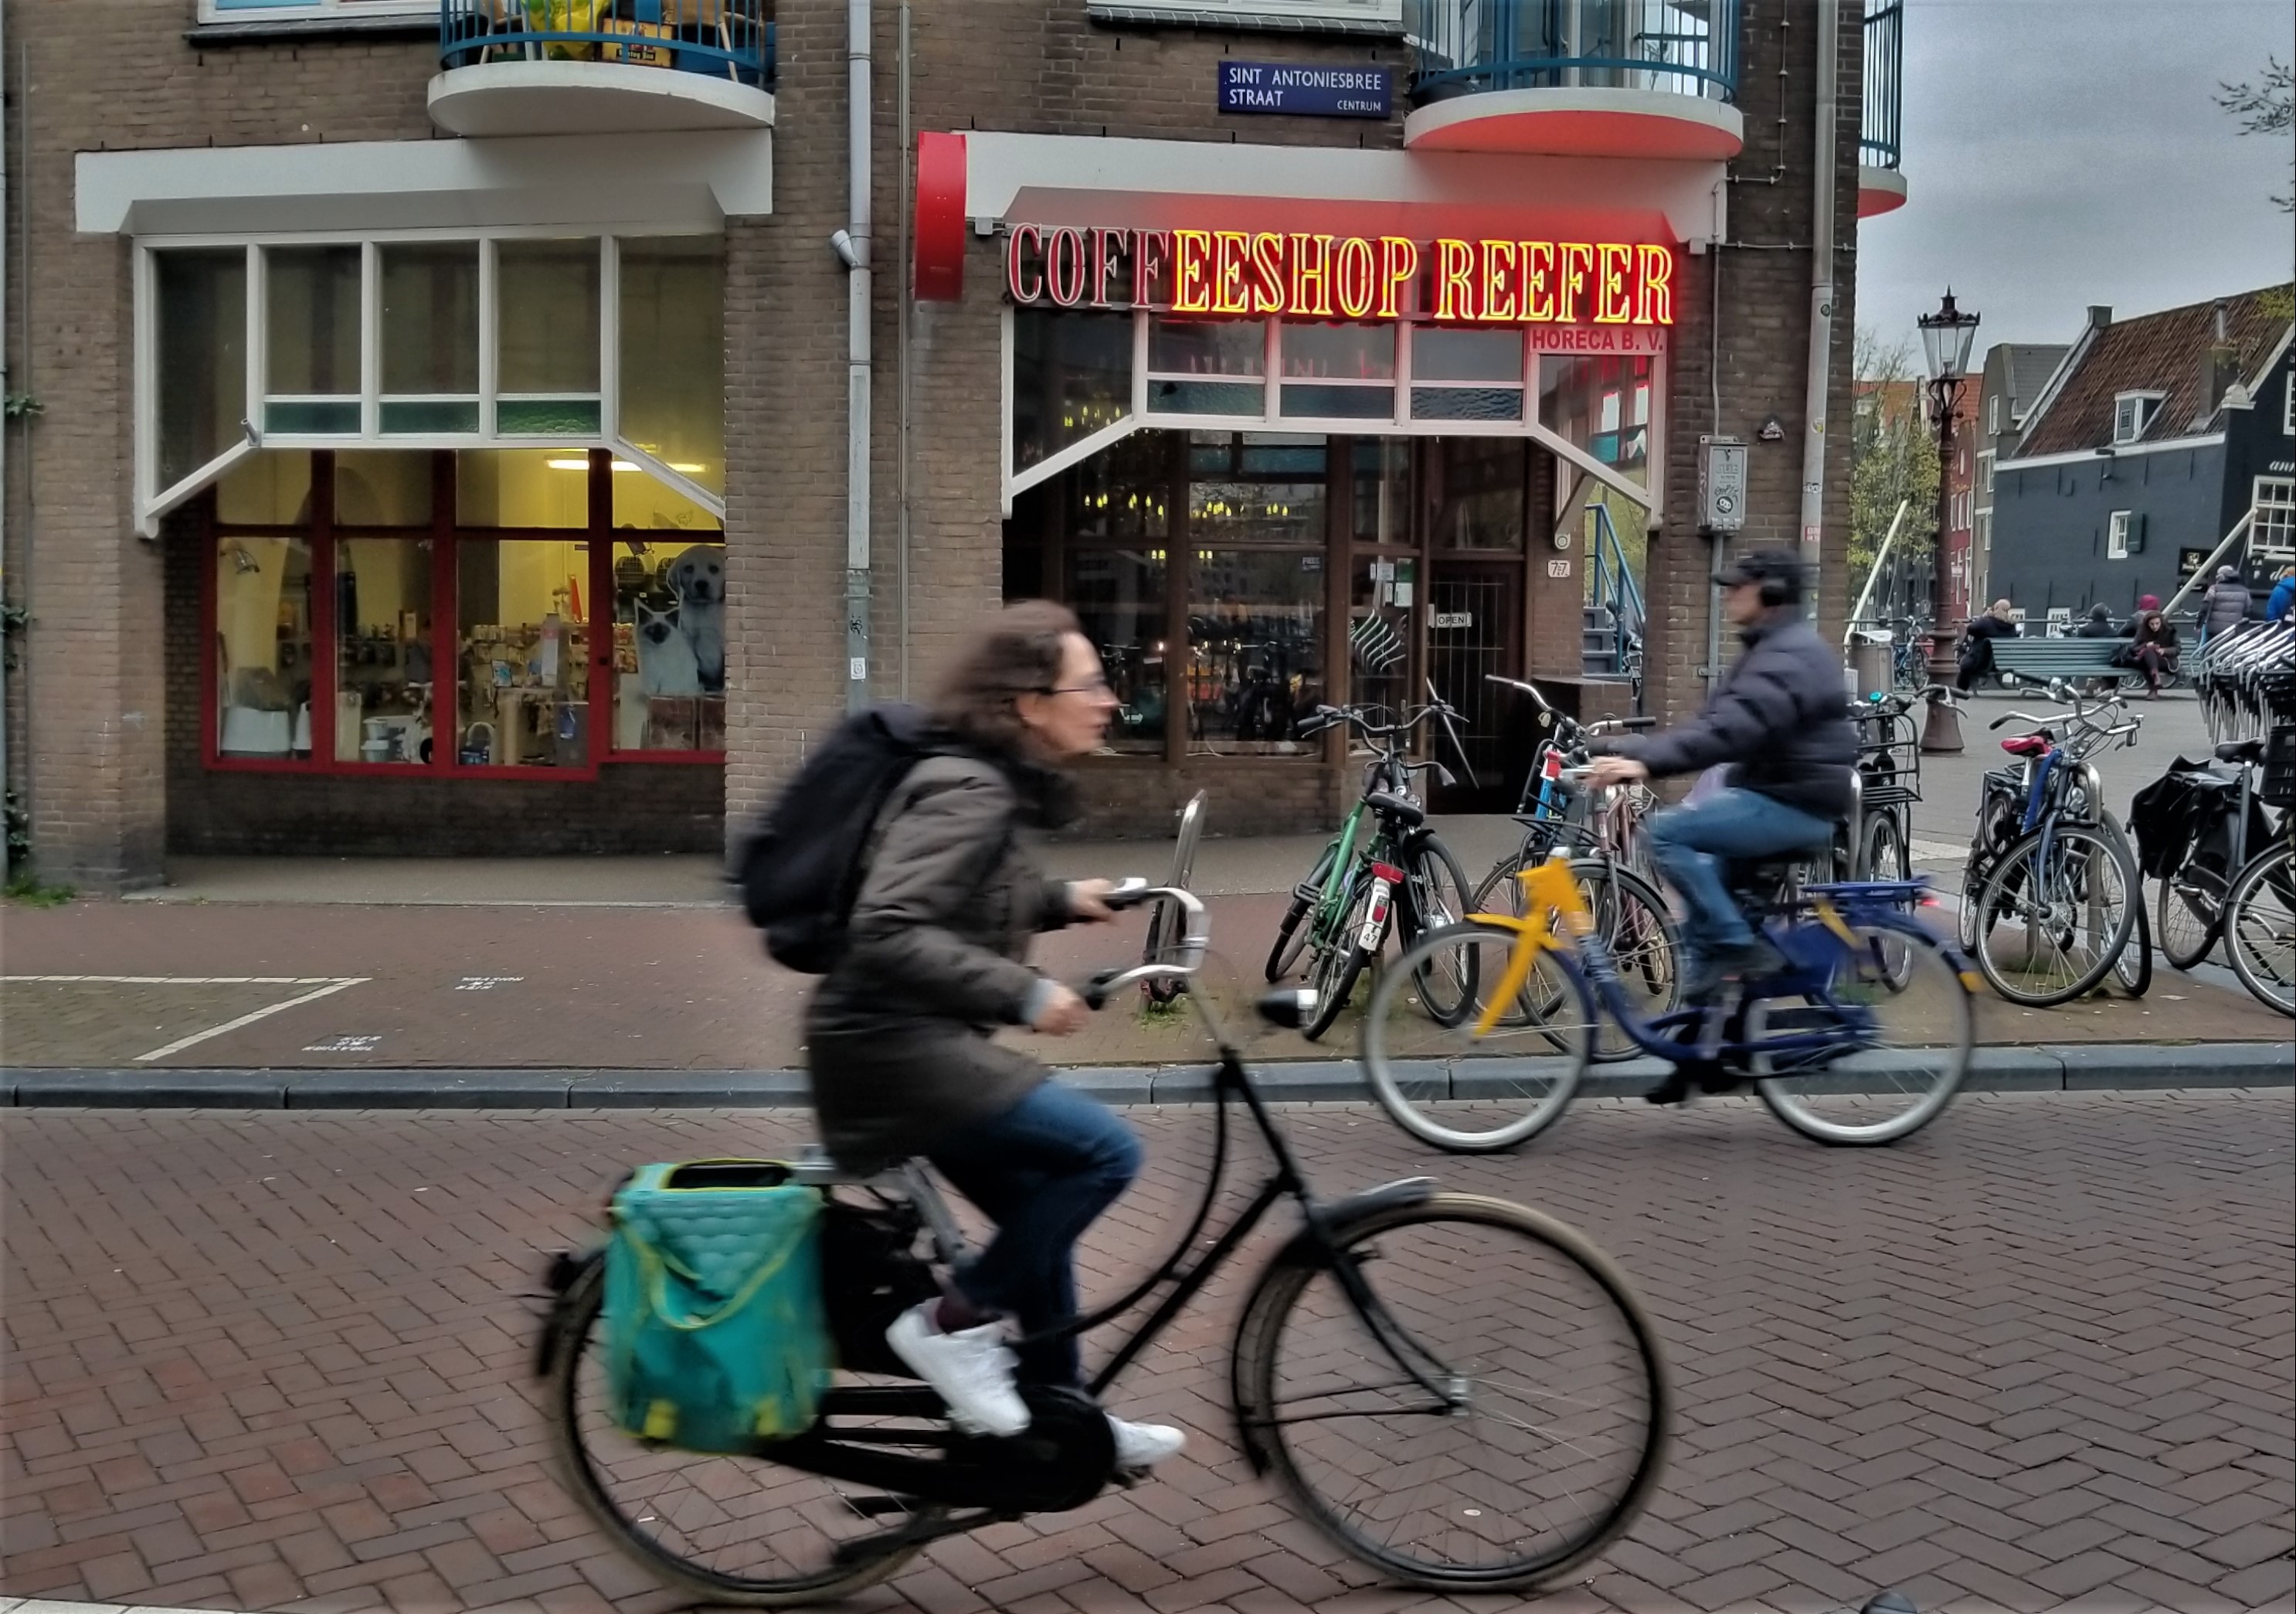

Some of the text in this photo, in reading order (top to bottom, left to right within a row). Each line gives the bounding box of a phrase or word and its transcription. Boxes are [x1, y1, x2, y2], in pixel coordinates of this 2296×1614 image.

[1229, 67, 1381, 90] SINT ANTONIESBREE
[1229, 89, 1284, 107] STRAAT
[1337, 100, 1381, 112] CENTRUM
[1007, 221, 1674, 324] COFFEESHOP REEFER
[1532, 329, 1664, 352] HORECA B. V.
[1438, 616, 1466, 625] OPEN
[1364, 933, 1377, 943] 47
